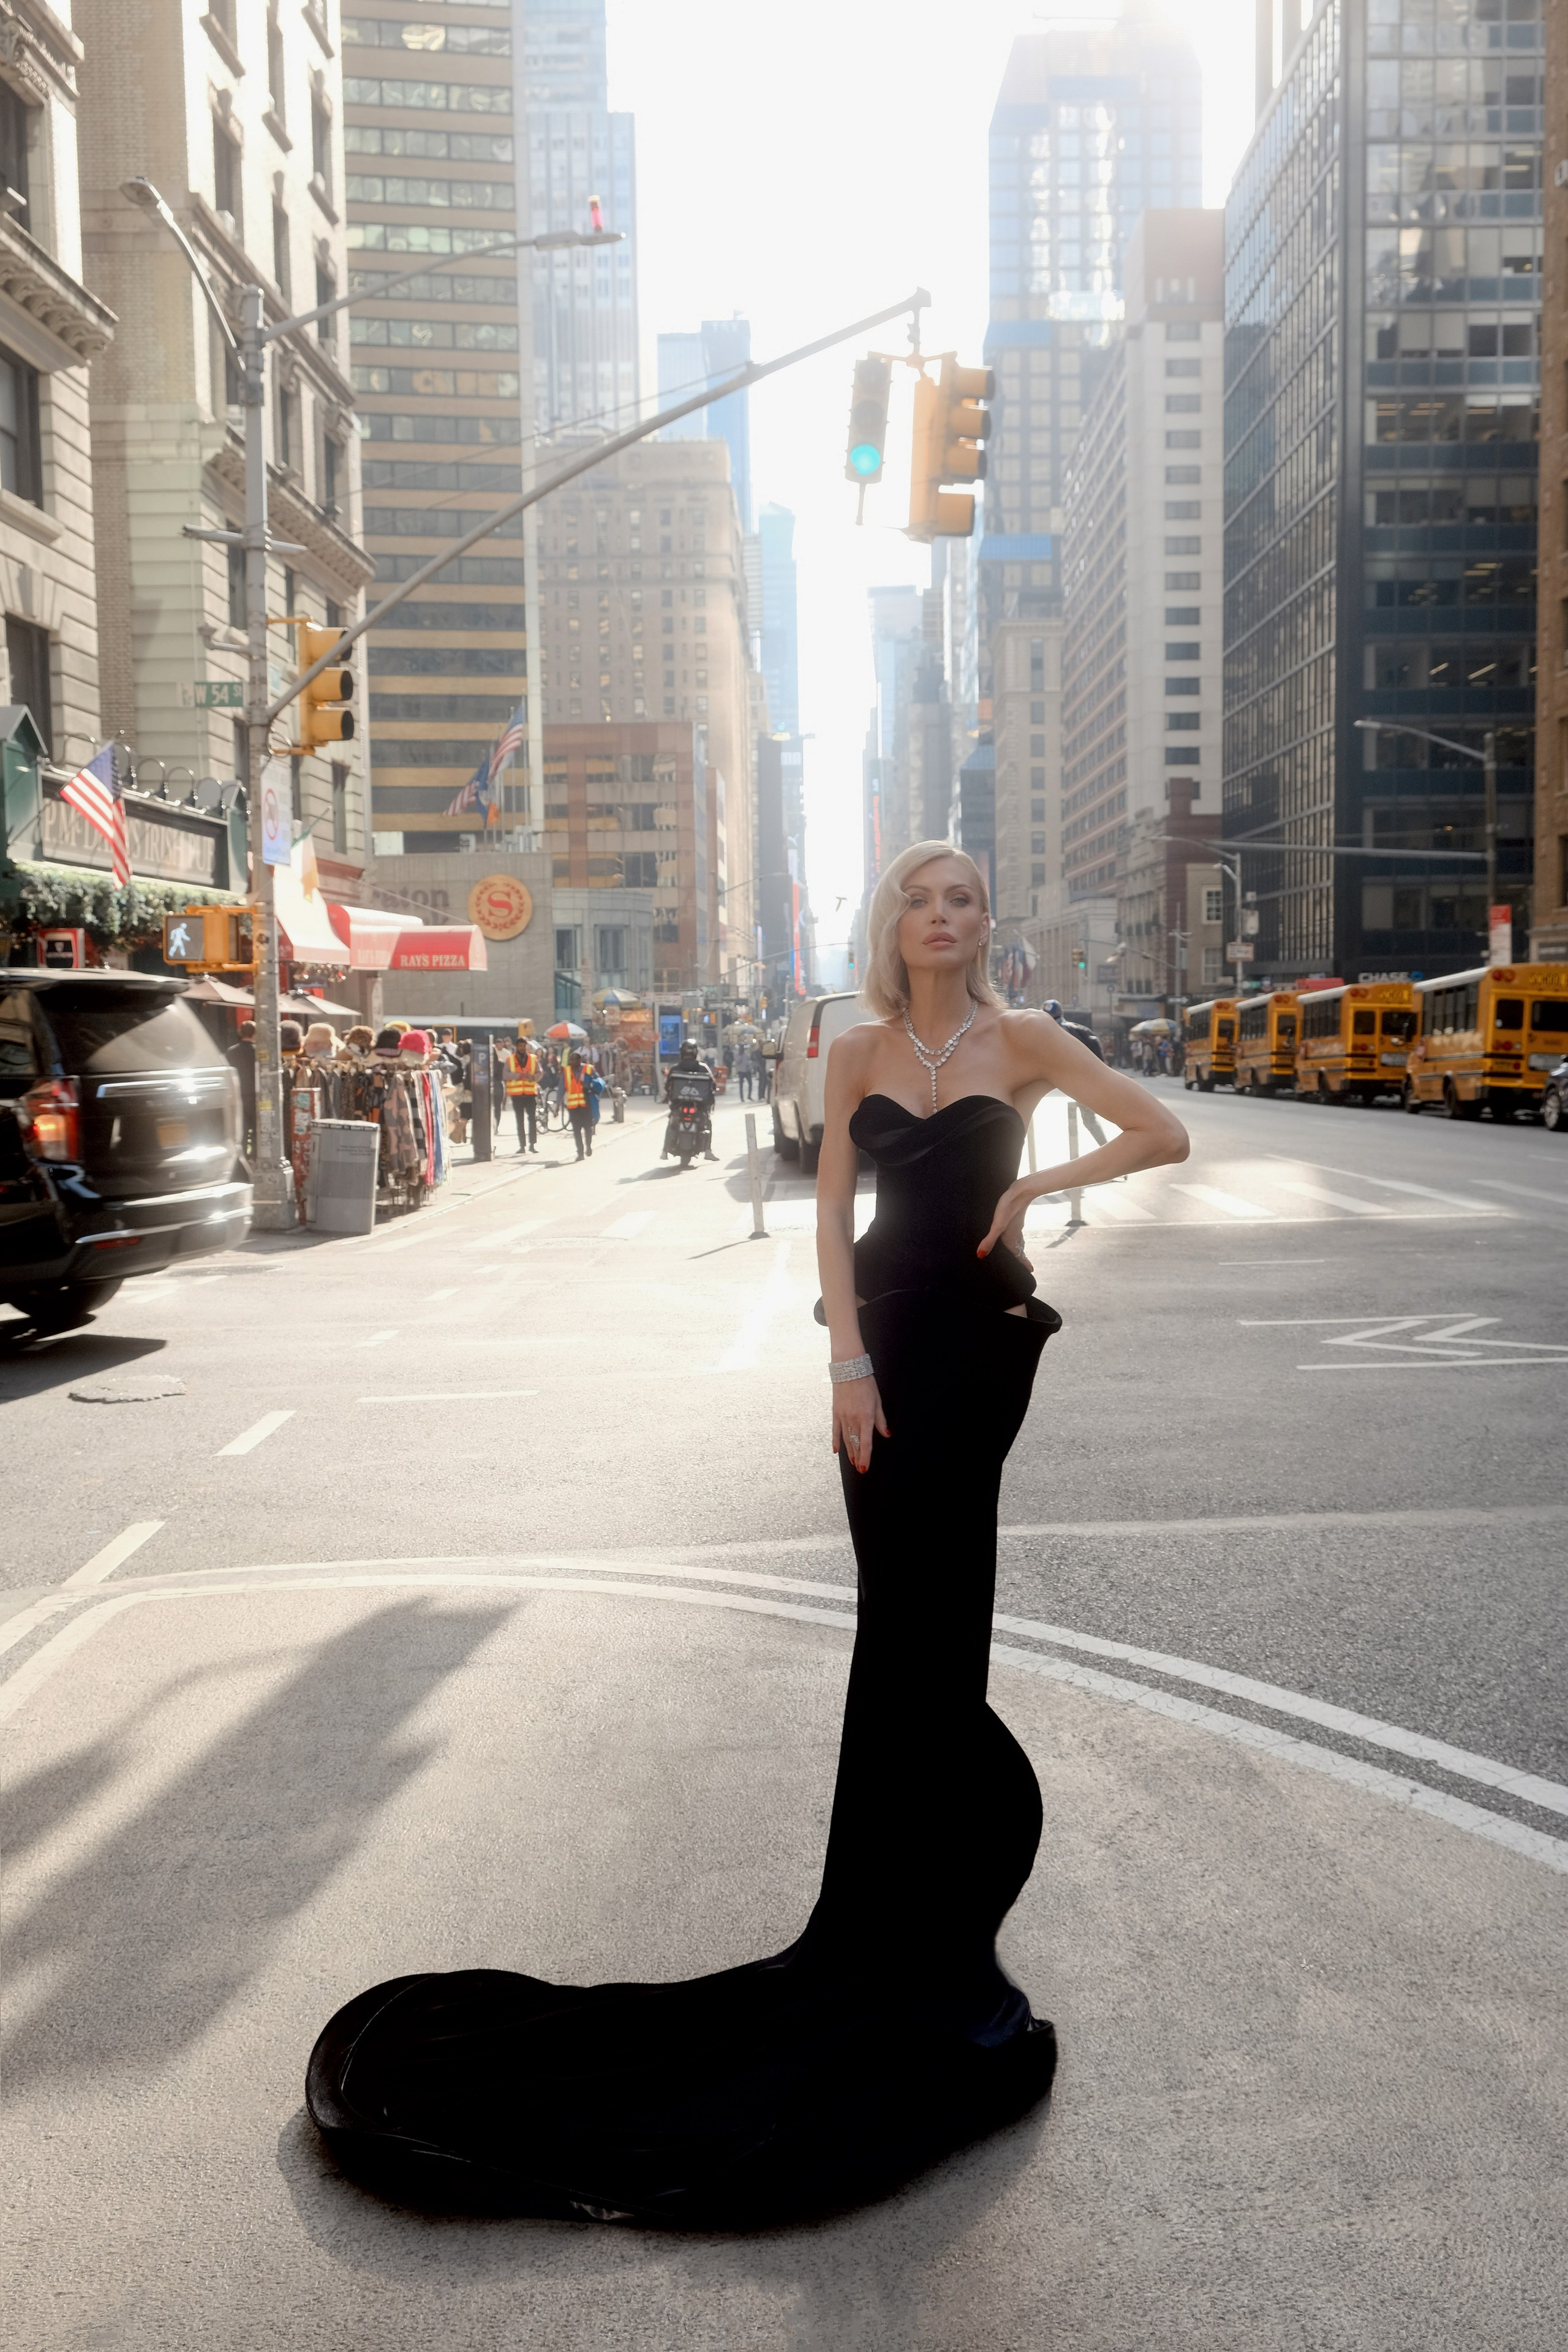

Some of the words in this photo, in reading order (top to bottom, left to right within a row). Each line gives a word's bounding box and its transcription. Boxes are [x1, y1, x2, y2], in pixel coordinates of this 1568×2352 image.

[195, 684, 207, 705] W
[211, 684, 230, 705] 54
[487, 891, 513, 918] S
[400, 953, 429, 967] RAY'S
[432, 954, 466, 967] PIZZA
[1358, 971, 1411, 984] CHASE
[478, 1052, 487, 1065] P
